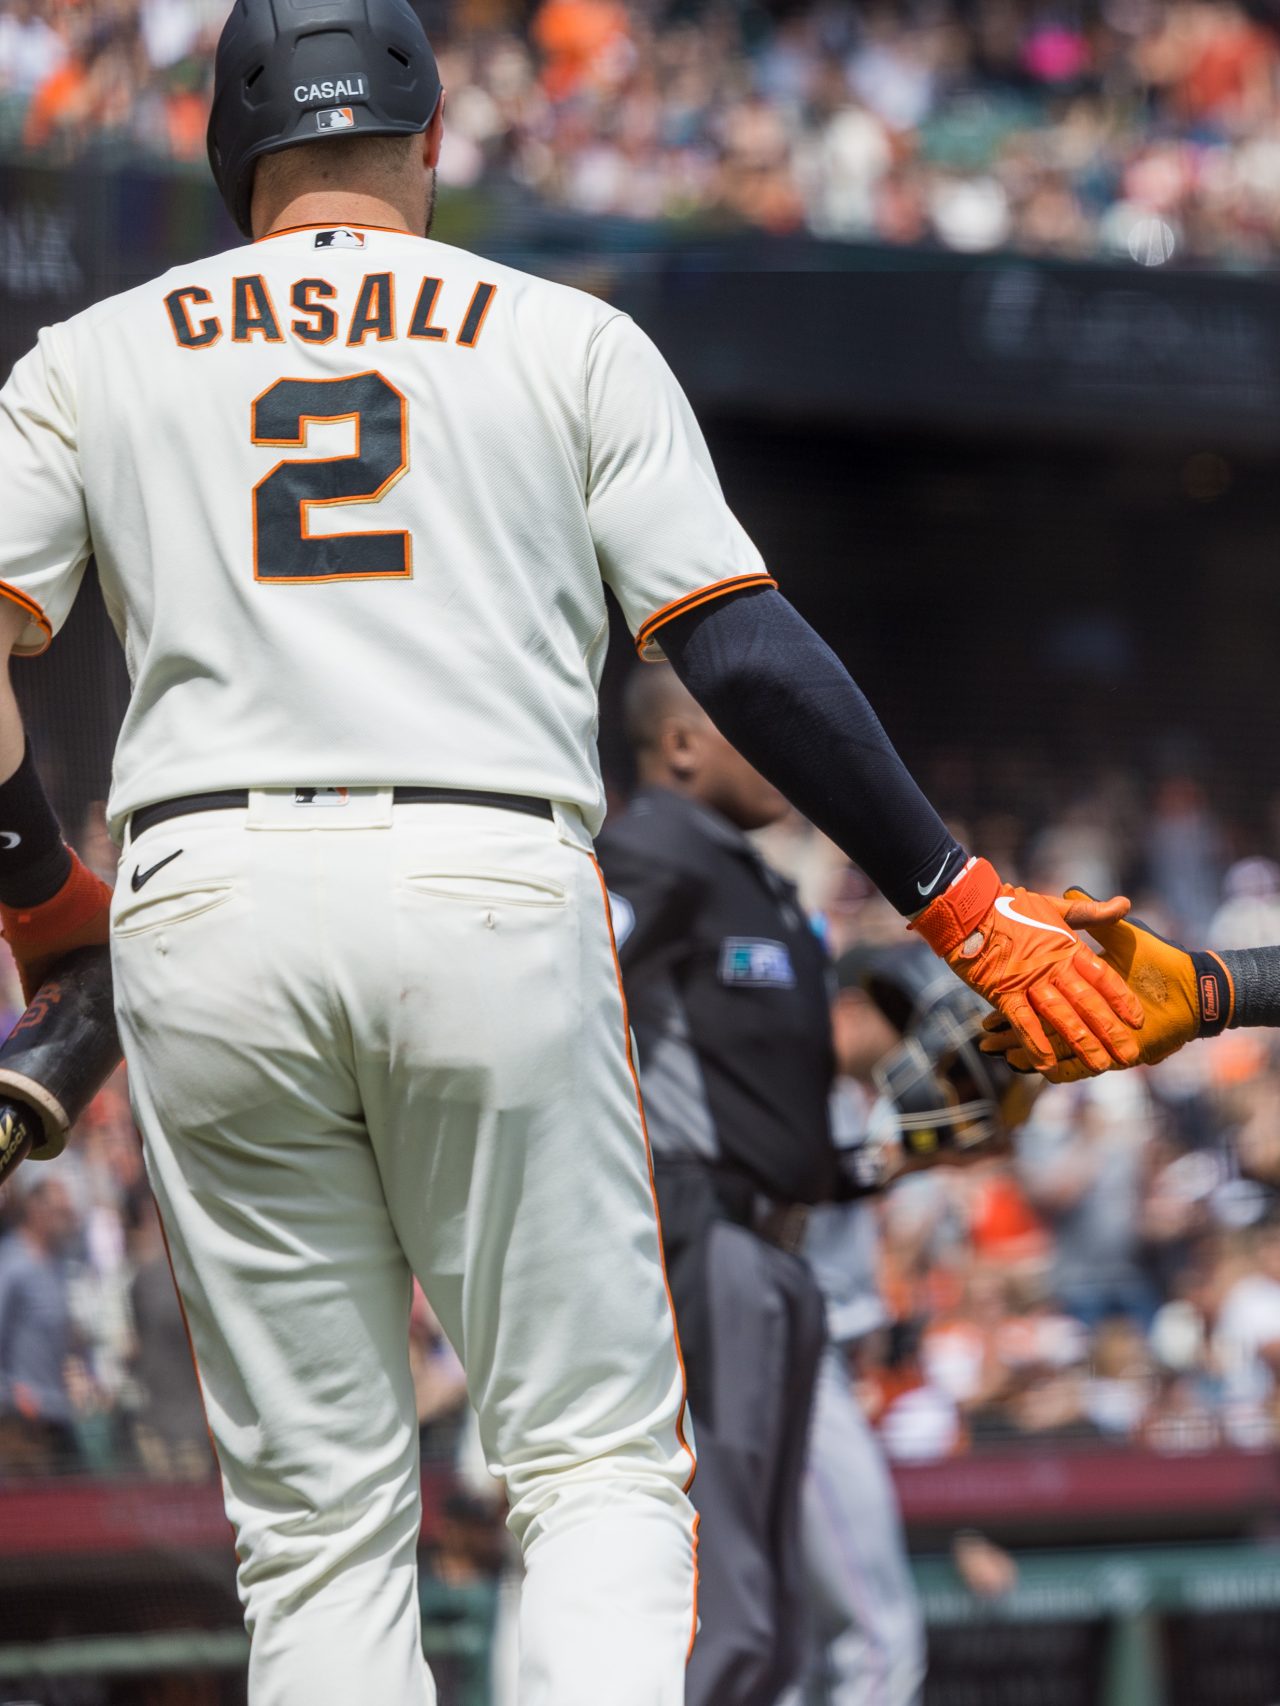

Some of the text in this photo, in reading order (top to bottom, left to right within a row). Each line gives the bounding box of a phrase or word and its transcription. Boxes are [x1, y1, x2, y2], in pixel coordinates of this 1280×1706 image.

[293, 78, 364, 103] CASALI
[163, 271, 498, 350] CASALI
[251, 369, 414, 586] 2
